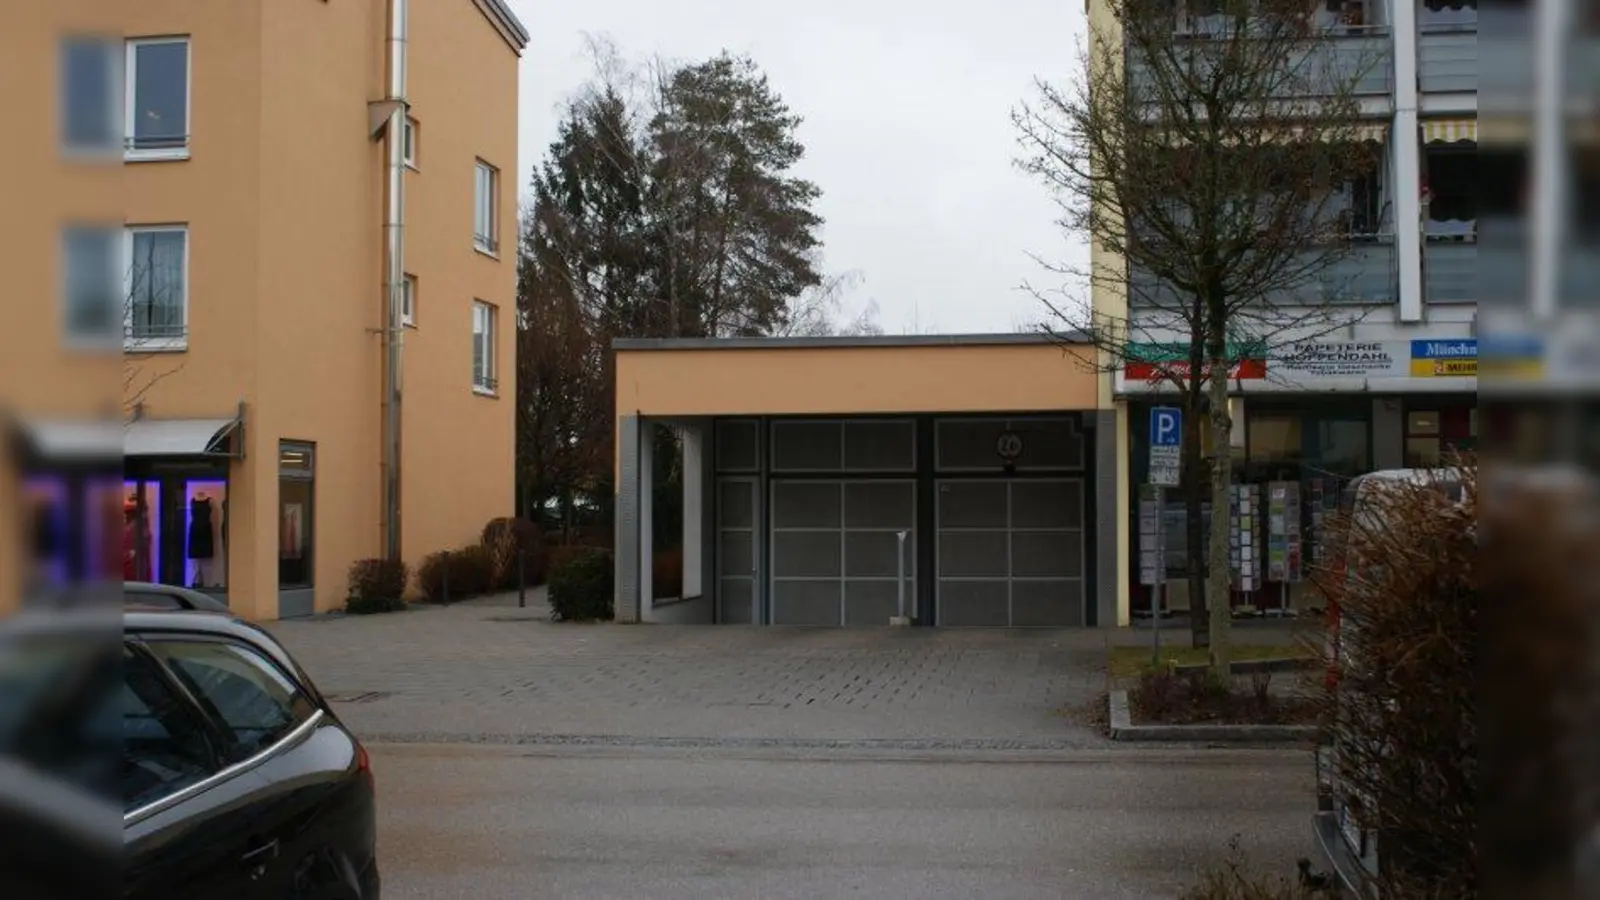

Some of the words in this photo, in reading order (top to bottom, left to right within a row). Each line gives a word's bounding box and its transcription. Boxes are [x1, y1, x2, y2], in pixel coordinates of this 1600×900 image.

[1294, 342, 1383, 353] PAPETERIE
[1282, 352, 1391, 363] HOPPENDAHL
[1158, 413, 1174, 444] P
